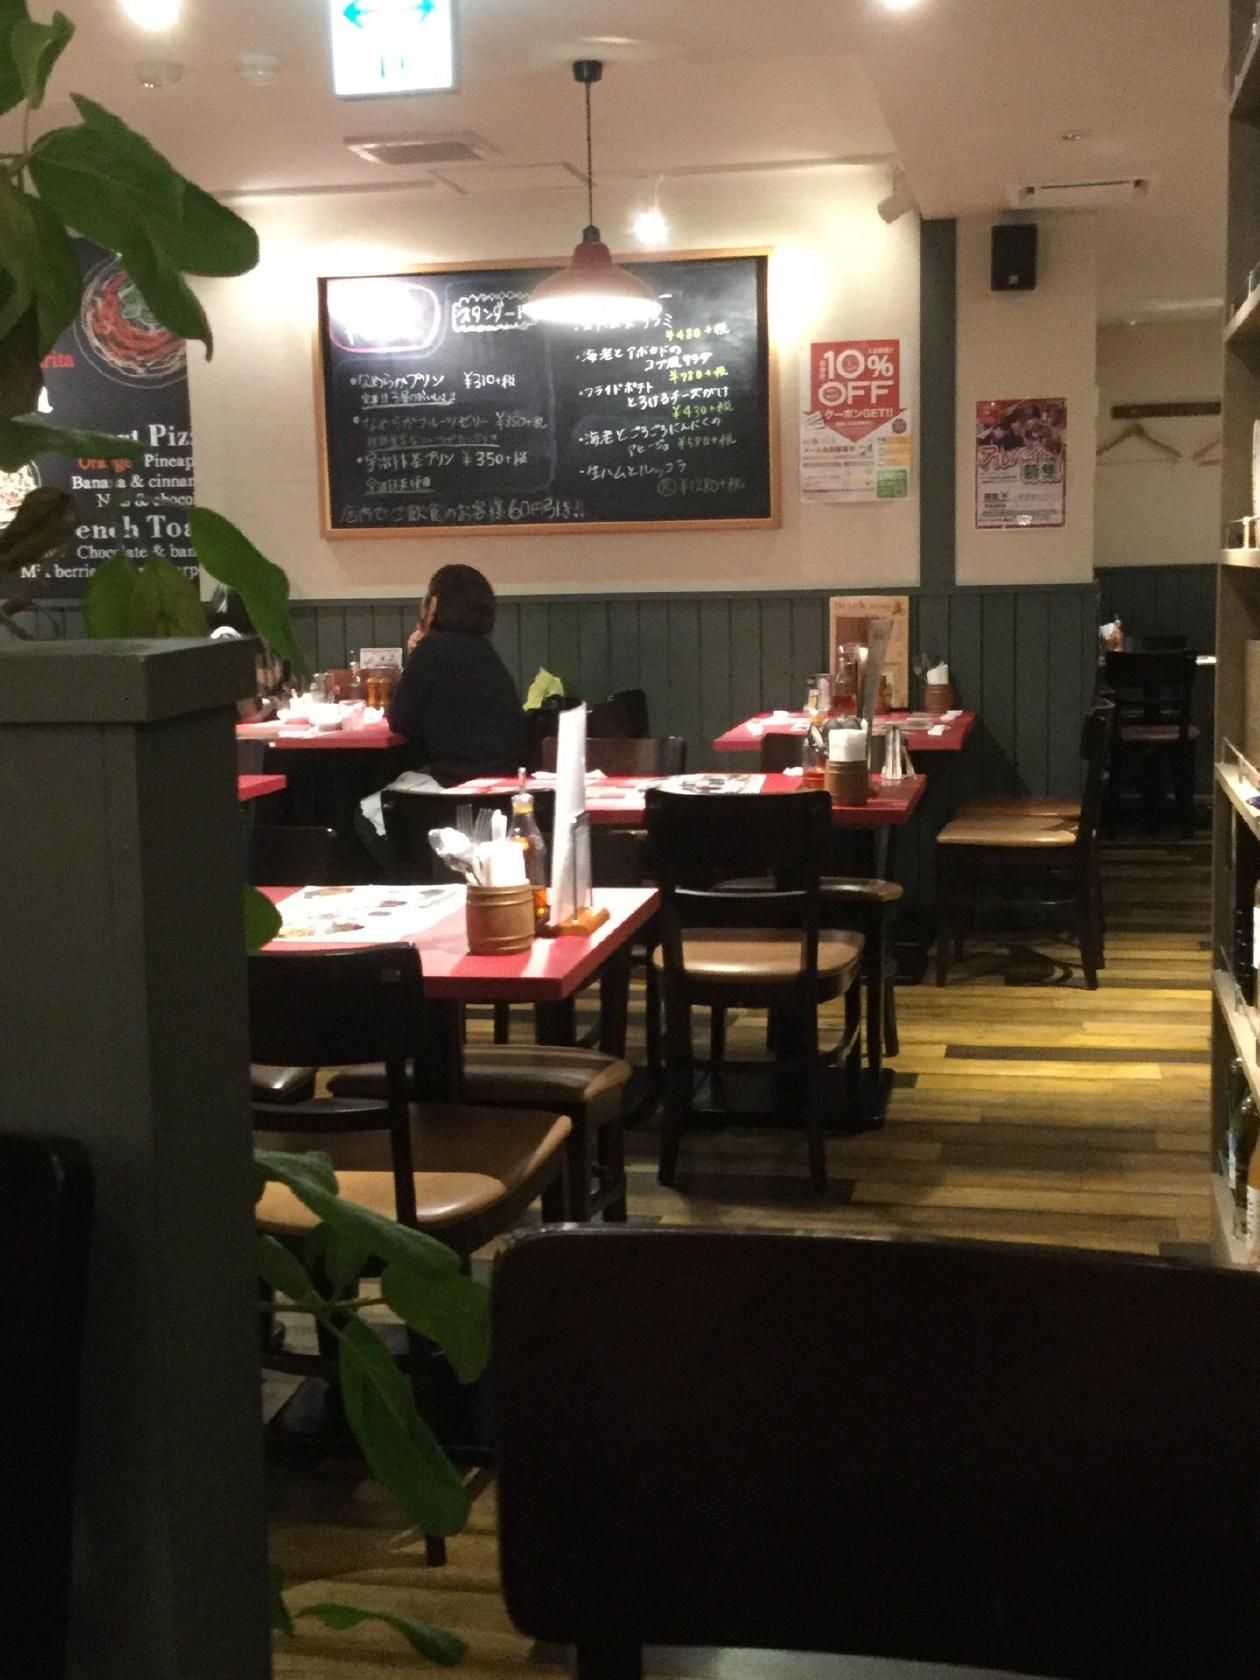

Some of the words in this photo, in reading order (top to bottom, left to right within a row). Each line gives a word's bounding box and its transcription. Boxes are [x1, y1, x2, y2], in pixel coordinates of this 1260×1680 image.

[818, 380, 895, 406] OFF
[149, 423, 192, 447] Piz
[72, 475, 128, 490] Banaa
